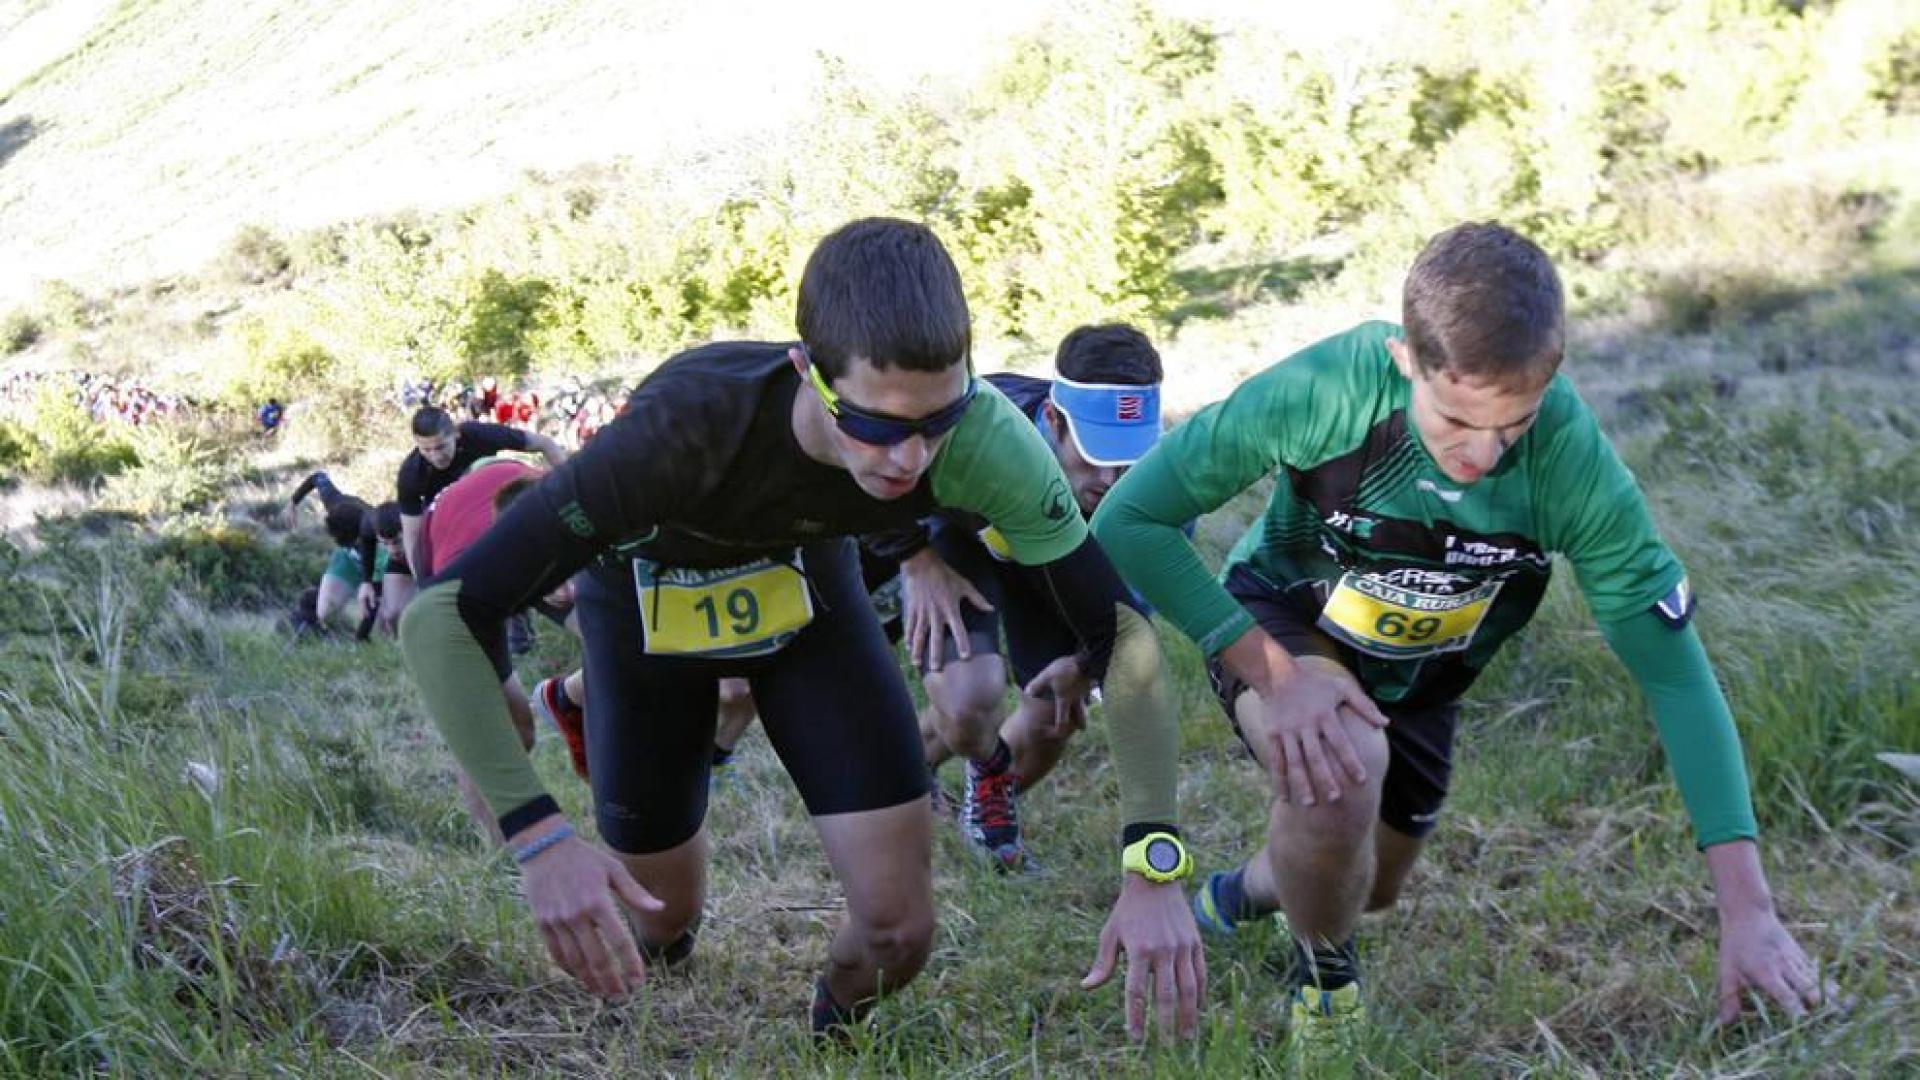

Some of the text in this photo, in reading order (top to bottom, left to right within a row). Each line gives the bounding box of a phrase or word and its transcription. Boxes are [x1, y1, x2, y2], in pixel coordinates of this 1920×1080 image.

[1355, 579, 1407, 606] CAJA
[695, 587, 759, 638] 19
[1375, 611, 1442, 641] 69
